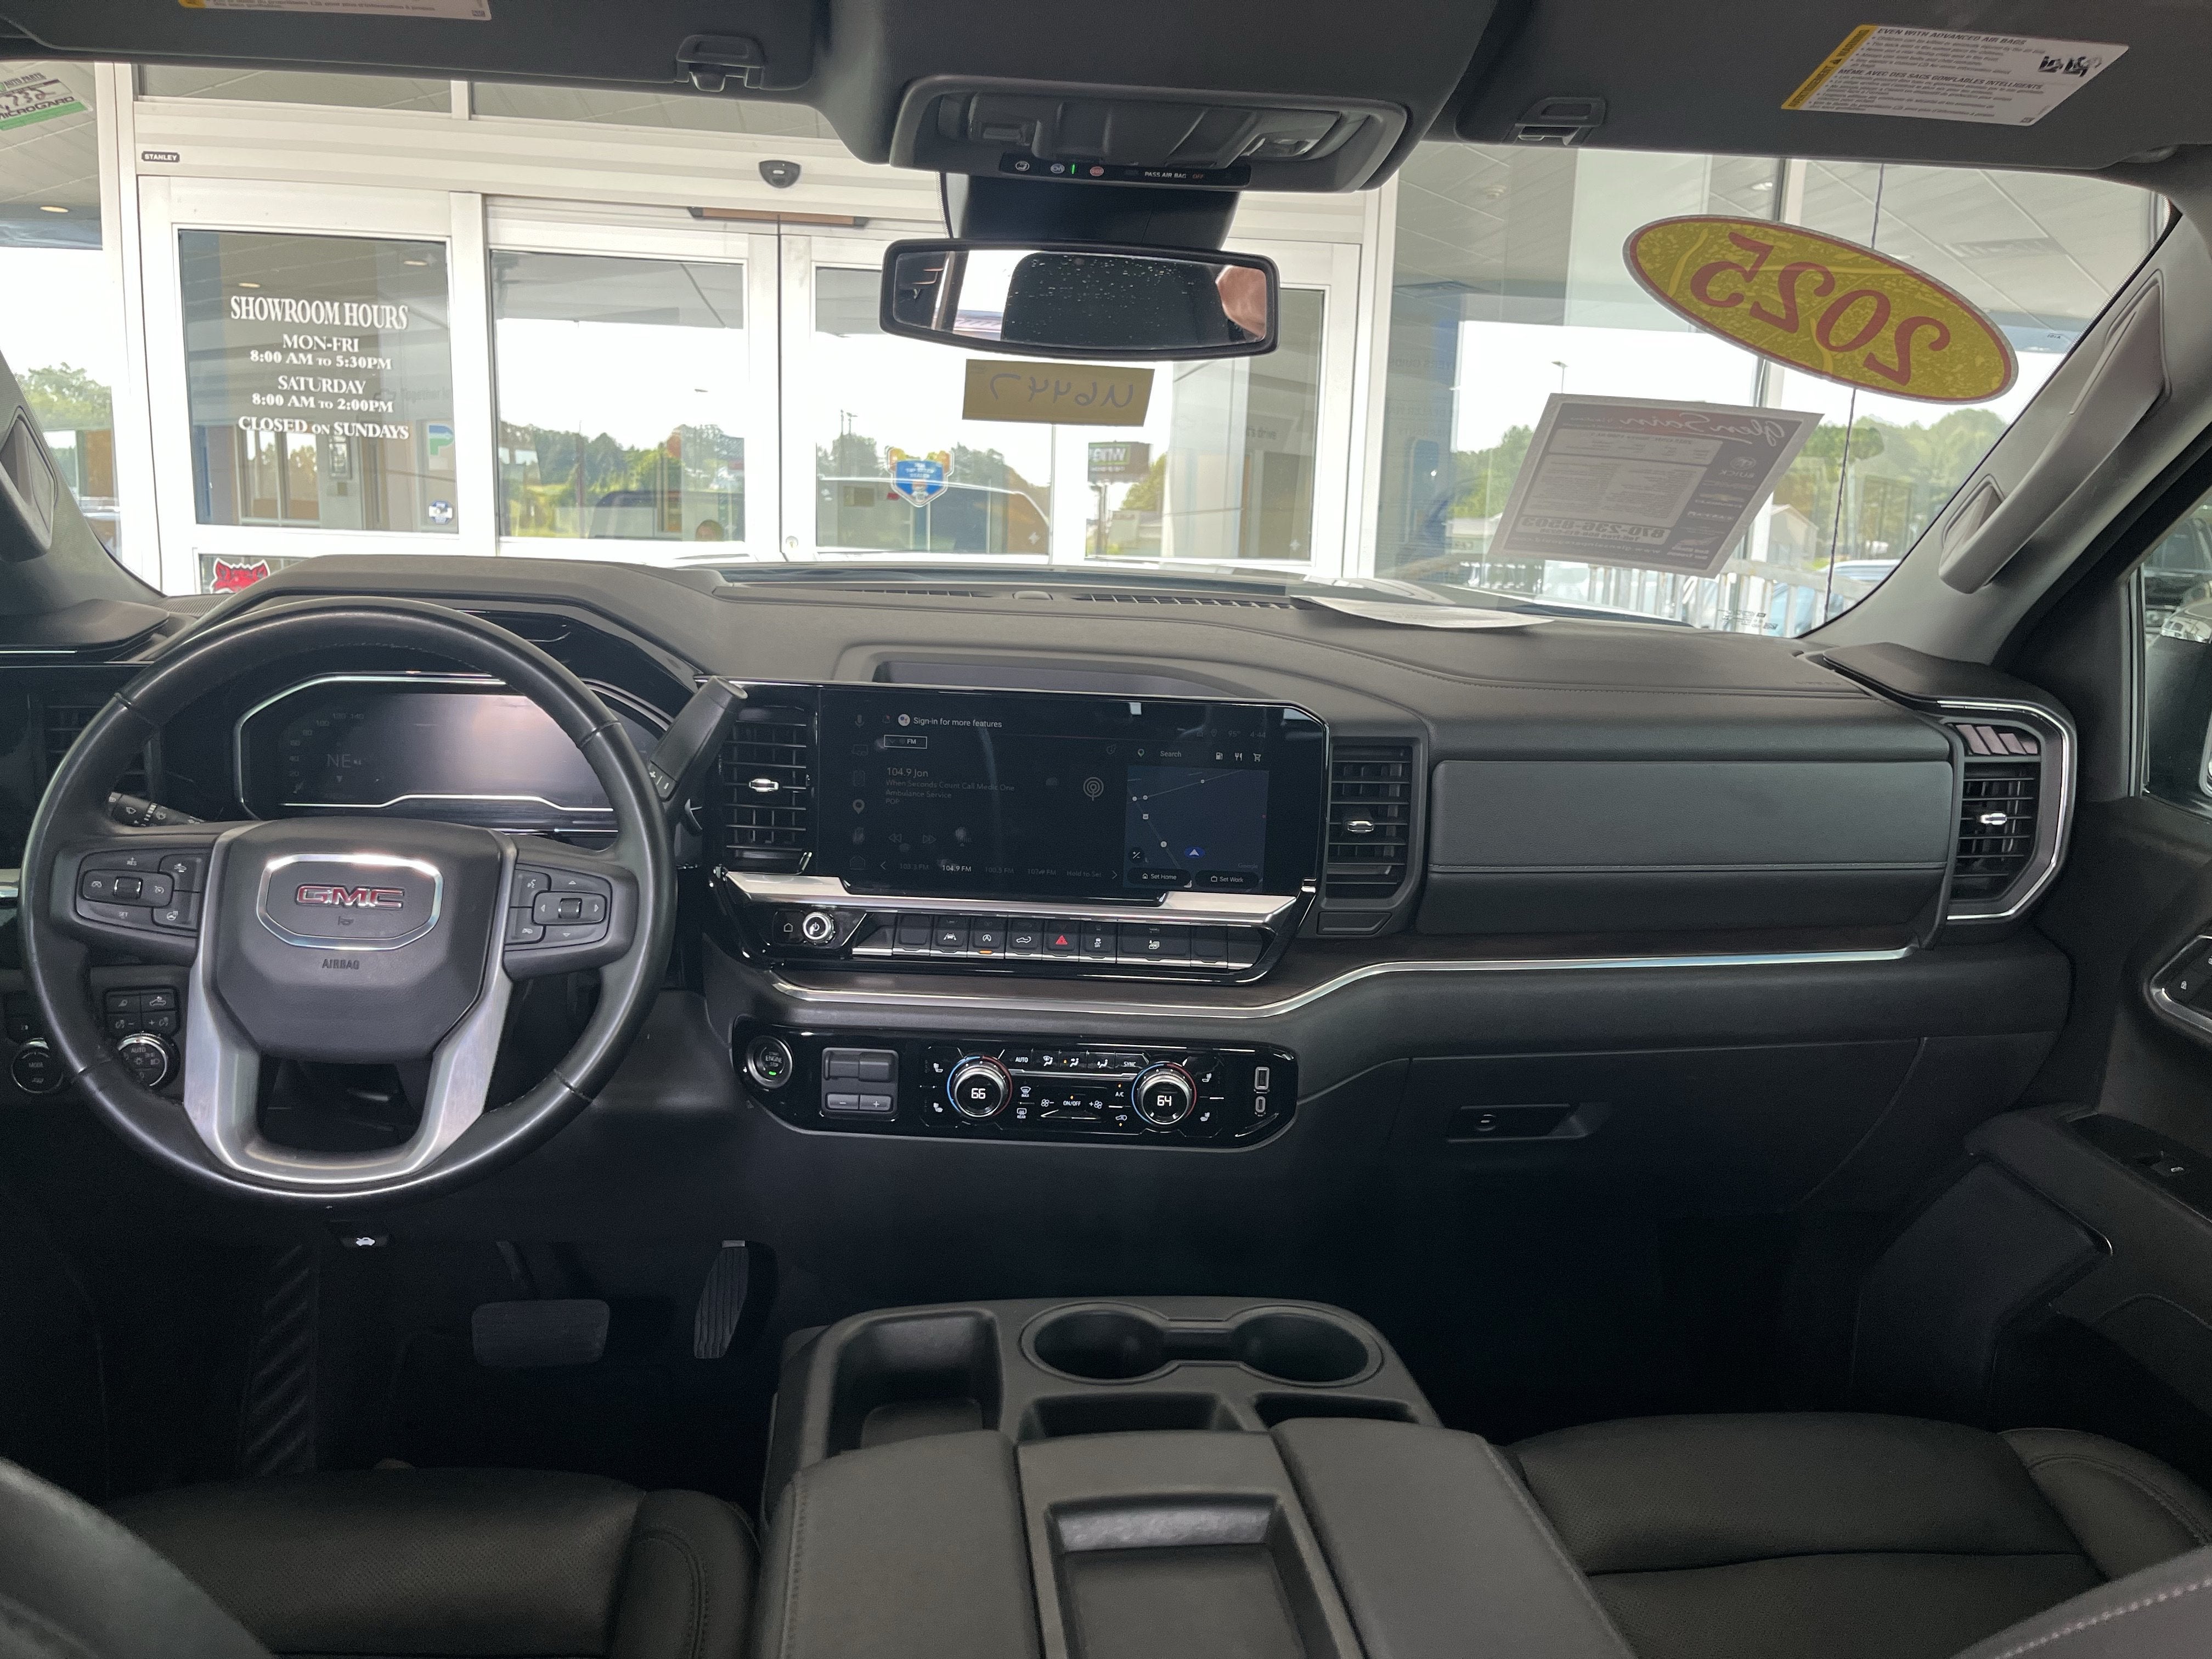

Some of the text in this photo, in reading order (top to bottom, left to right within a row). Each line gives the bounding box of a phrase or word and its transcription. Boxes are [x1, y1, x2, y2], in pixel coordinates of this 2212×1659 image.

[1929, 32, 1980, 41] ADVANCED
[4, 72, 47, 86] AUTO PARTS
[1931, 75, 1985, 84] GONFLABLES
[1985, 81, 2044, 89] INTELLIGENTS
[230, 295, 409, 330] SHOWROOM HOURS
[283, 334, 359, 352] MON-FRI
[250, 349, 282, 363] 8:00
[285, 352, 314, 366] AM
[336, 355, 392, 370] 5:30PM
[278, 375, 366, 395] SATURDAY
[252, 392, 284, 406] 8:00
[287, 395, 316, 409] AM
[337, 398, 394, 413] 2:00PM
[238, 415, 308, 434] CLOSED
[334, 421, 410, 439] SUNDAYS
[913, 717, 938, 726] Sign-in
[973, 719, 1002, 728] features
[327, 753, 351, 768] NE
[887, 767, 928, 778] 104.9 Jon
[927, 791, 952, 799] Service
[296, 884, 404, 909] GMC
[321, 959, 360, 970] AIRBAG
[971, 1087, 986, 1099] 66
[1156, 1095, 1172, 1107] 64
